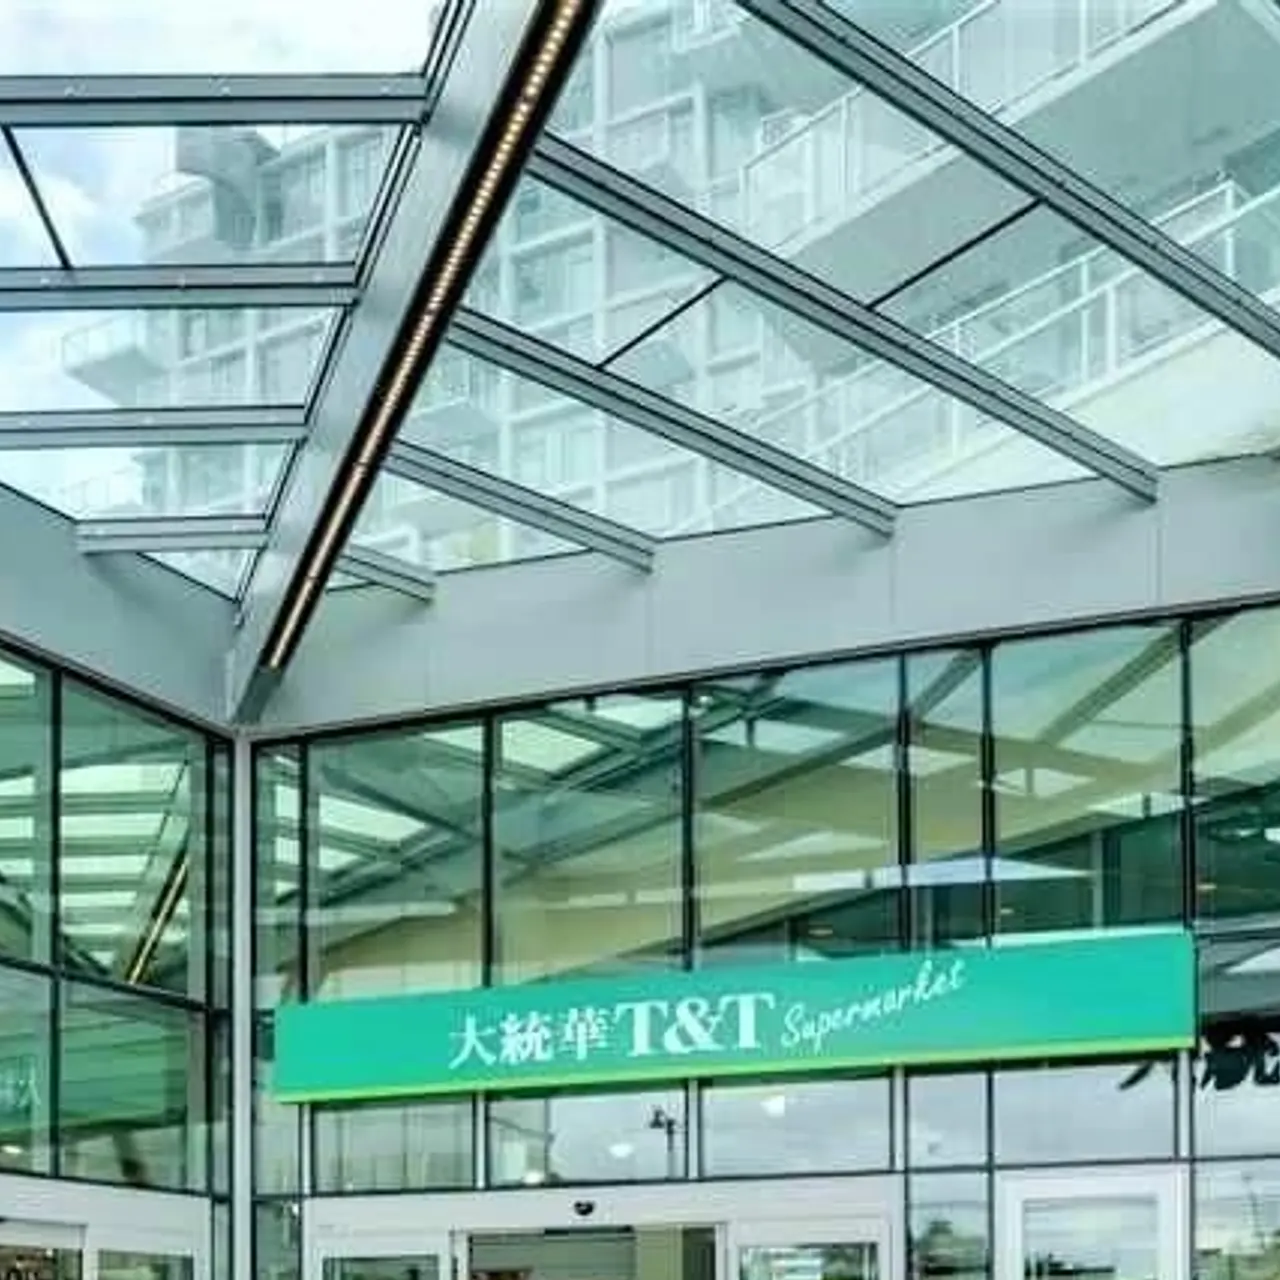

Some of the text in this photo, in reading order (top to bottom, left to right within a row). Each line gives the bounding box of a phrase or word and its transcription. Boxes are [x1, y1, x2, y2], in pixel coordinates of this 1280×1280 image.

[448, 957, 966, 1069] 大統華 T&T Supermarket
